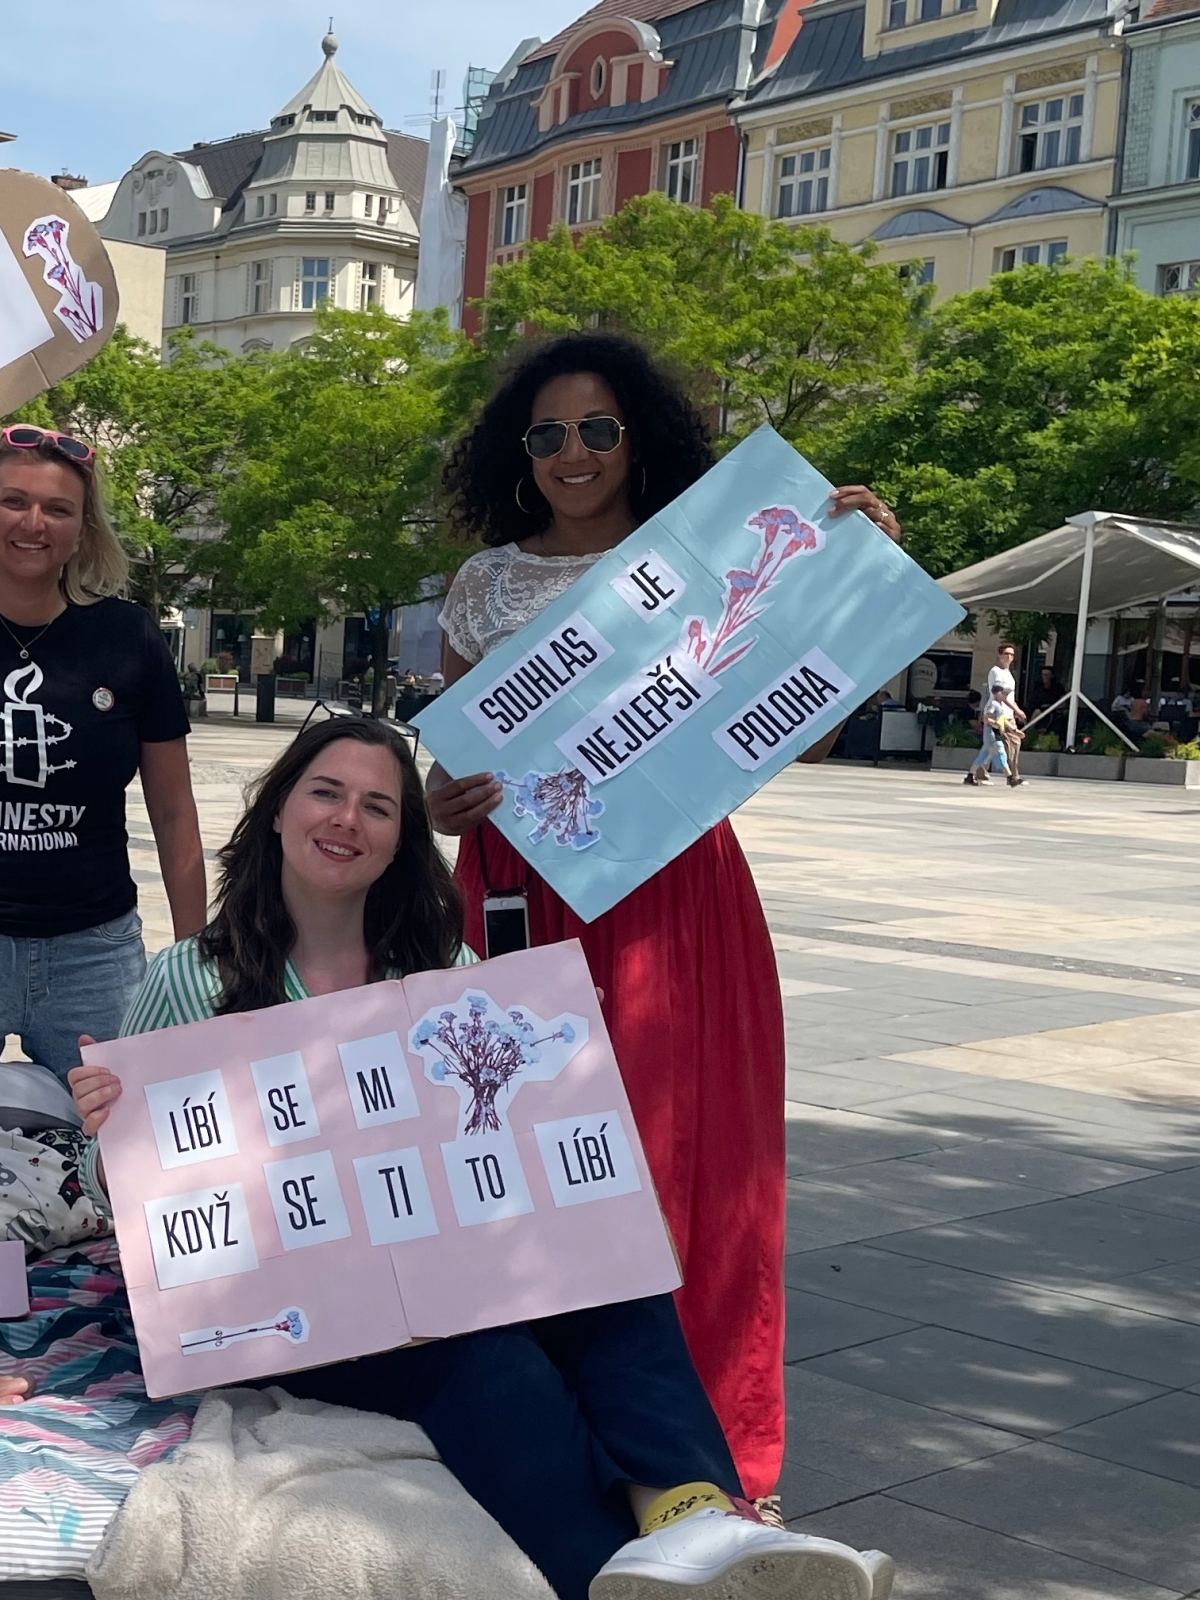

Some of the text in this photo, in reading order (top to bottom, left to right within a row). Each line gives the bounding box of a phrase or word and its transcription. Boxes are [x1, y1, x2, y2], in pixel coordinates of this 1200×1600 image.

[478, 561, 676, 734] SOUHLAS JE
[576, 655, 841, 777] NEJLEPŠÍ POLOHA
[168, 1065, 397, 1154] LÍBÍ SE MI
[162, 1122, 617, 1259] KDYŽ SE TI TO LÍBÍ
